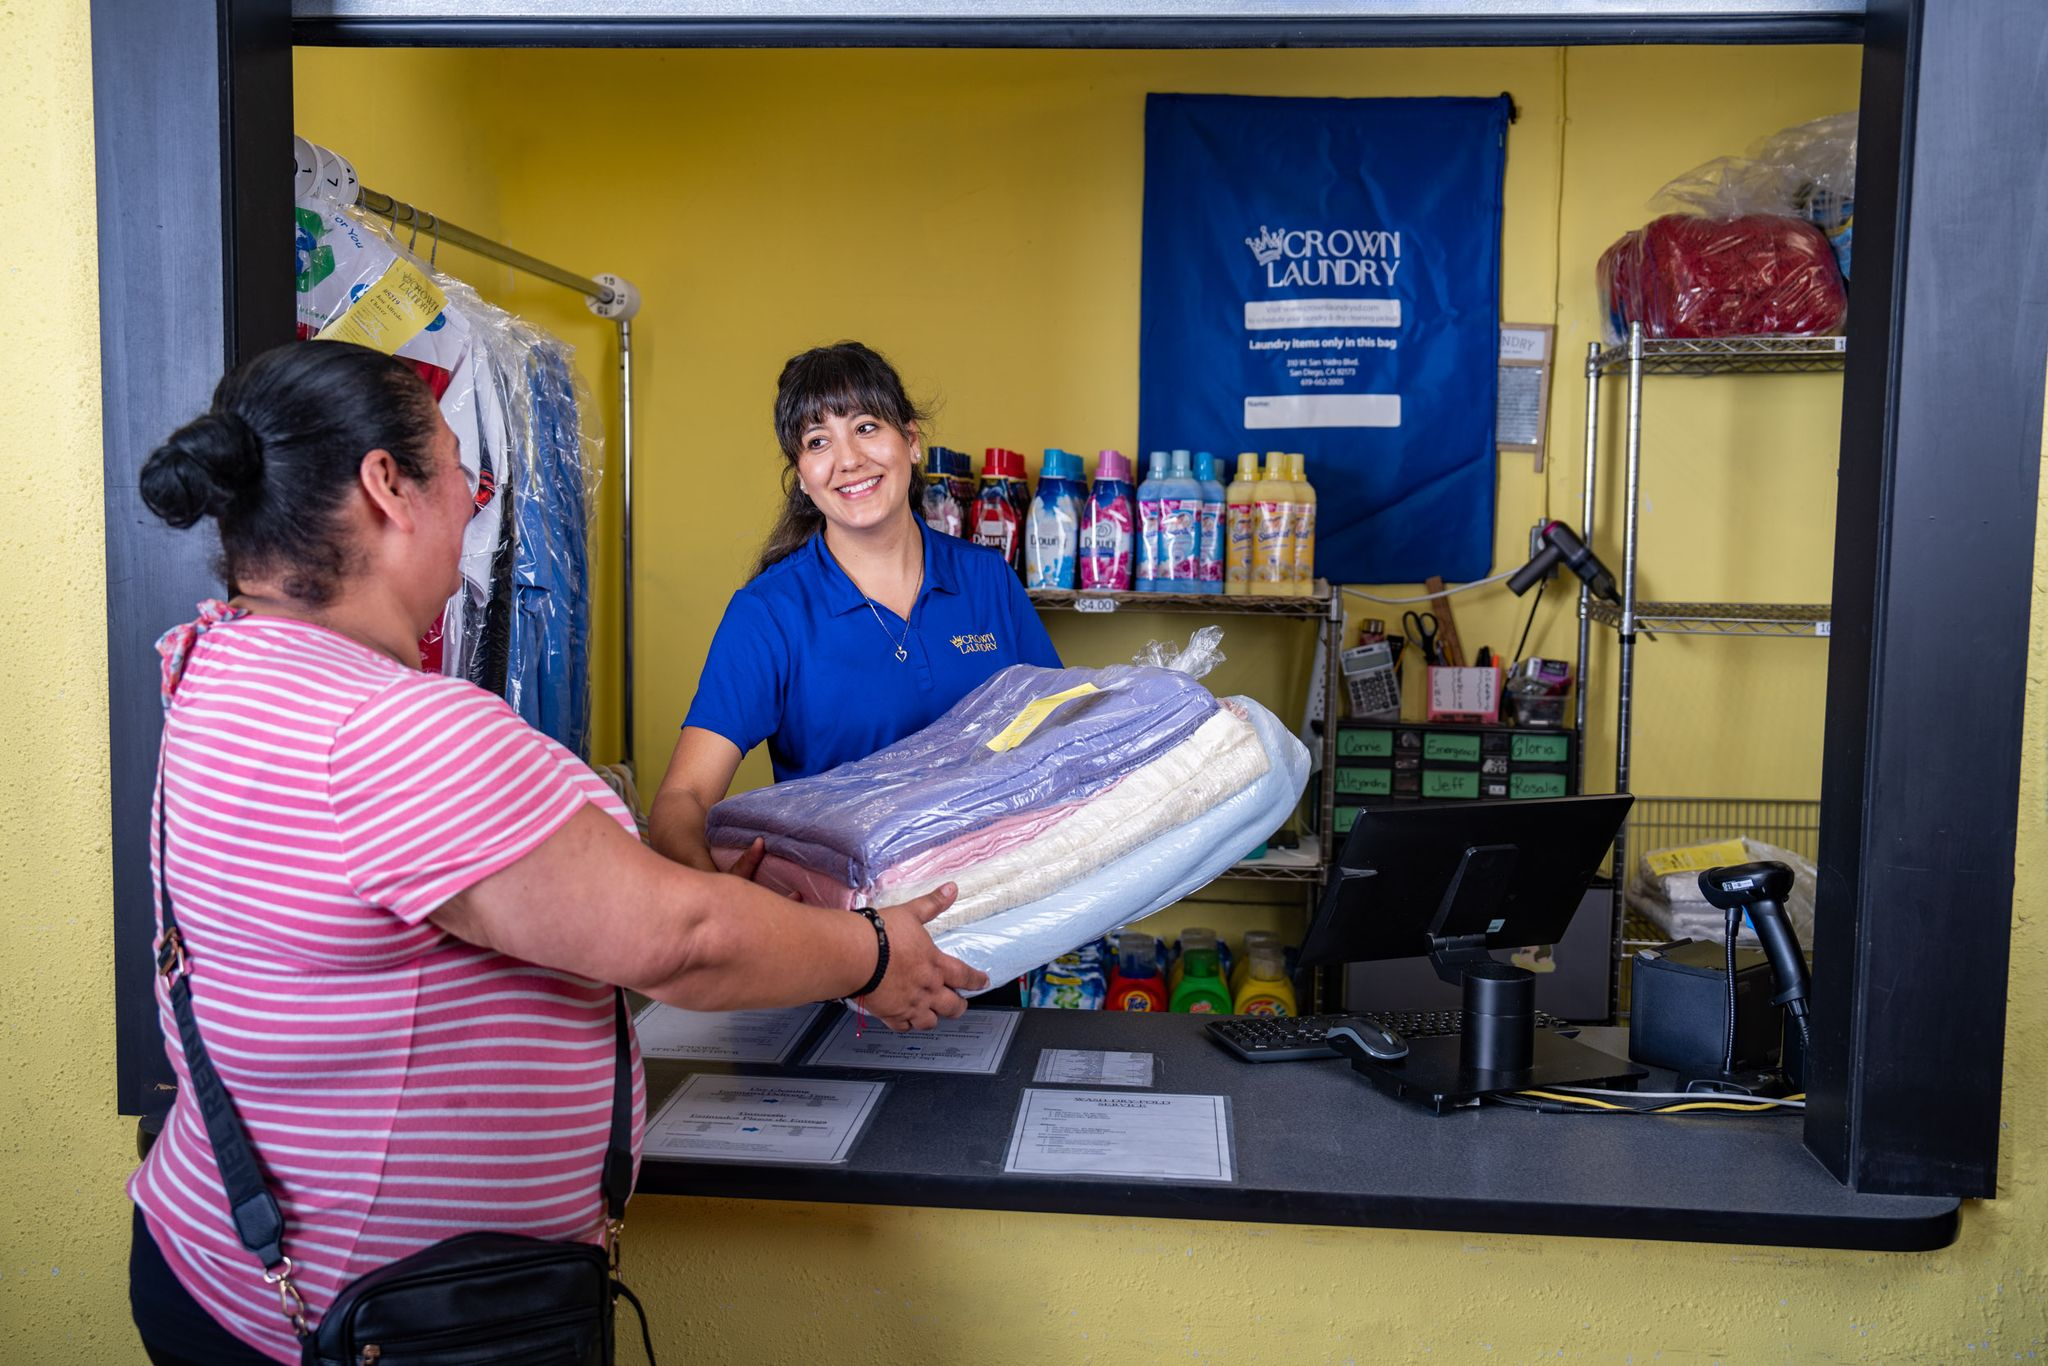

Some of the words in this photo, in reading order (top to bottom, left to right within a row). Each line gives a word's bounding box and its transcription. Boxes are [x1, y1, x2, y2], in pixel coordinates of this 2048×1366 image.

[348, 228, 364, 249] You
[1283, 229, 1400, 258] CROWN
[1267, 259, 1400, 287] LAUNDRY
[604, 276, 615, 286] 15
[399, 282, 434, 316] LAUNDRY
[410, 281, 441, 312] CROWN
[1249, 338, 1290, 350] Laundry
[1292, 338, 1320, 348] items
[1321, 337, 1344, 350] only
[1345, 337, 1355, 347] in
[1356, 337, 1376, 348] this
[1377, 337, 1397, 350] bag
[1501, 335, 1536, 351] NDRY
[1308, 358, 1321, 366] San
[1289, 369, 1302, 377] San
[1303, 368, 1324, 377] Diego,
[1325, 368, 1336, 376] CA
[973, 534, 1008, 549] Downy
[1081, 600, 1112, 611] $4.00
[961, 632, 995, 645] CROWN
[960, 641, 997, 655] LAUNDRY
[1344, 735, 1382, 754] Connie
[1512, 736, 1557, 757] Gloria
[1431, 776, 1465, 792] Jeff
[1127, 997, 1148, 1010] Tide
